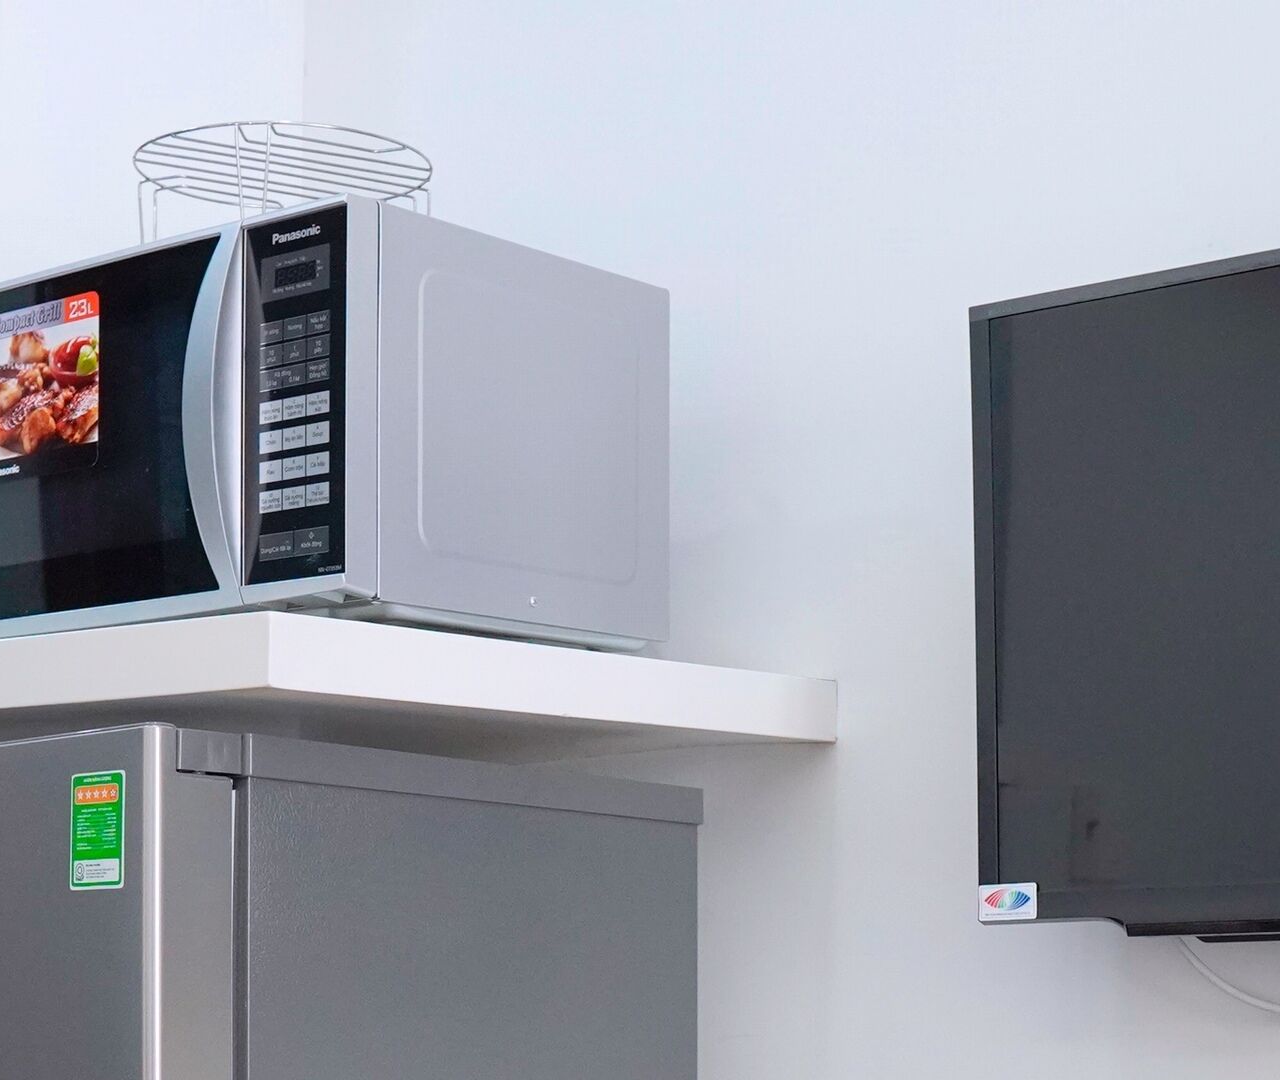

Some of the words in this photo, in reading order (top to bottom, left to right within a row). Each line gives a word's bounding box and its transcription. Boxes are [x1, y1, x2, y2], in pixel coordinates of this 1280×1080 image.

[272, 224, 321, 245] Panasonic
[36, 301, 62, 324] Grill
[69, 298, 94, 319] 23L
